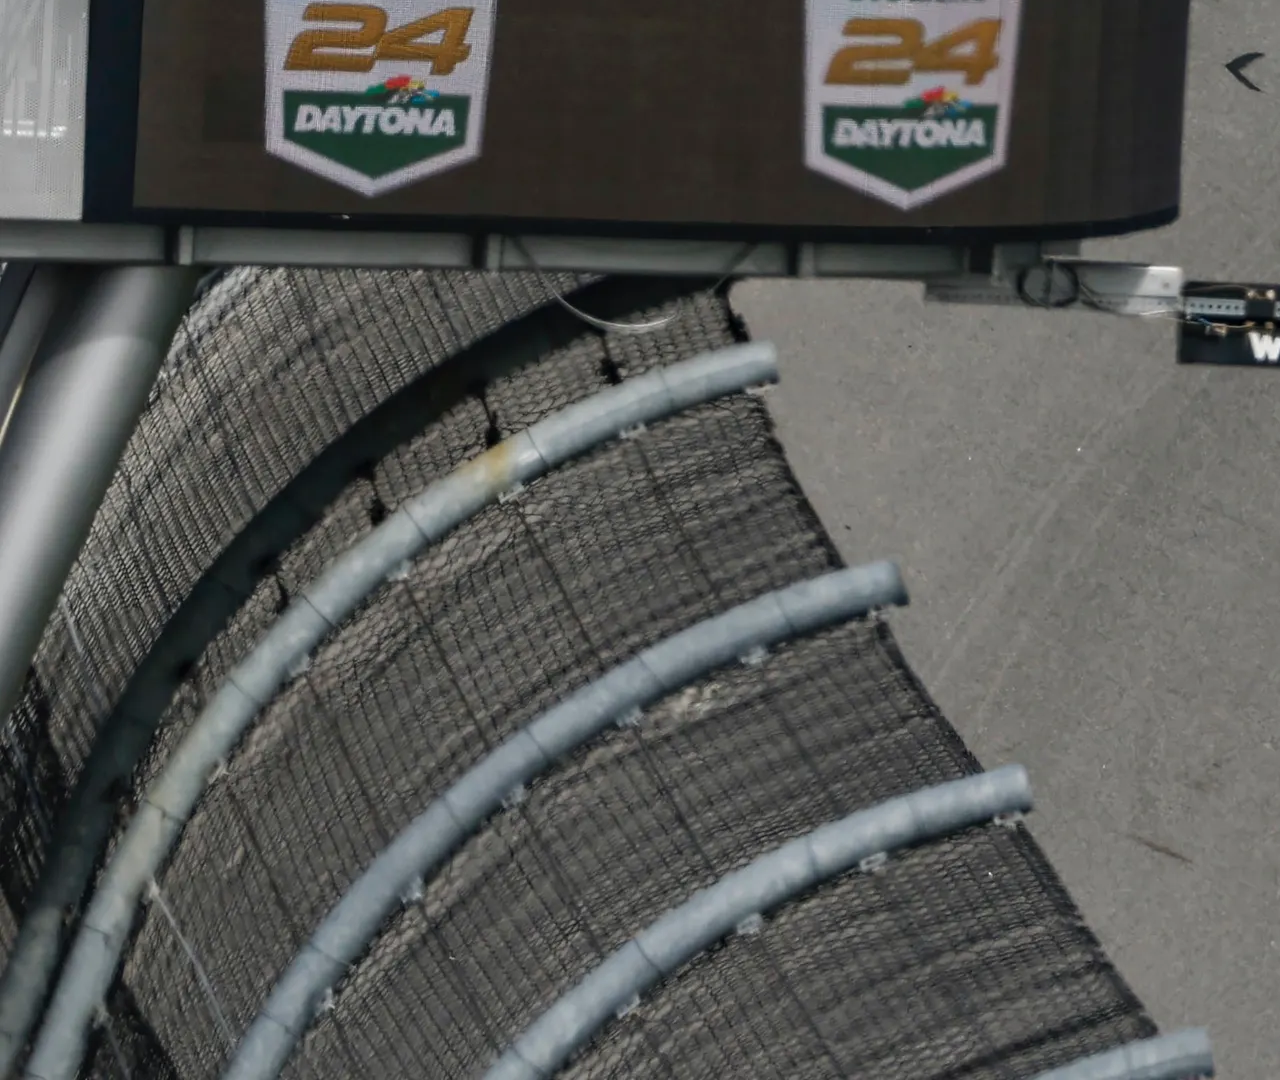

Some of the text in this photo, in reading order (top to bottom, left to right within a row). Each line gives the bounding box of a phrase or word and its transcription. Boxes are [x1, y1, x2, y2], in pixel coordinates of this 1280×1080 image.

[283, 1, 474, 76] 24
[824, 17, 1004, 86] 24
[294, 105, 456, 136] DAYTONA
[832, 118, 986, 148] DAYTONA
